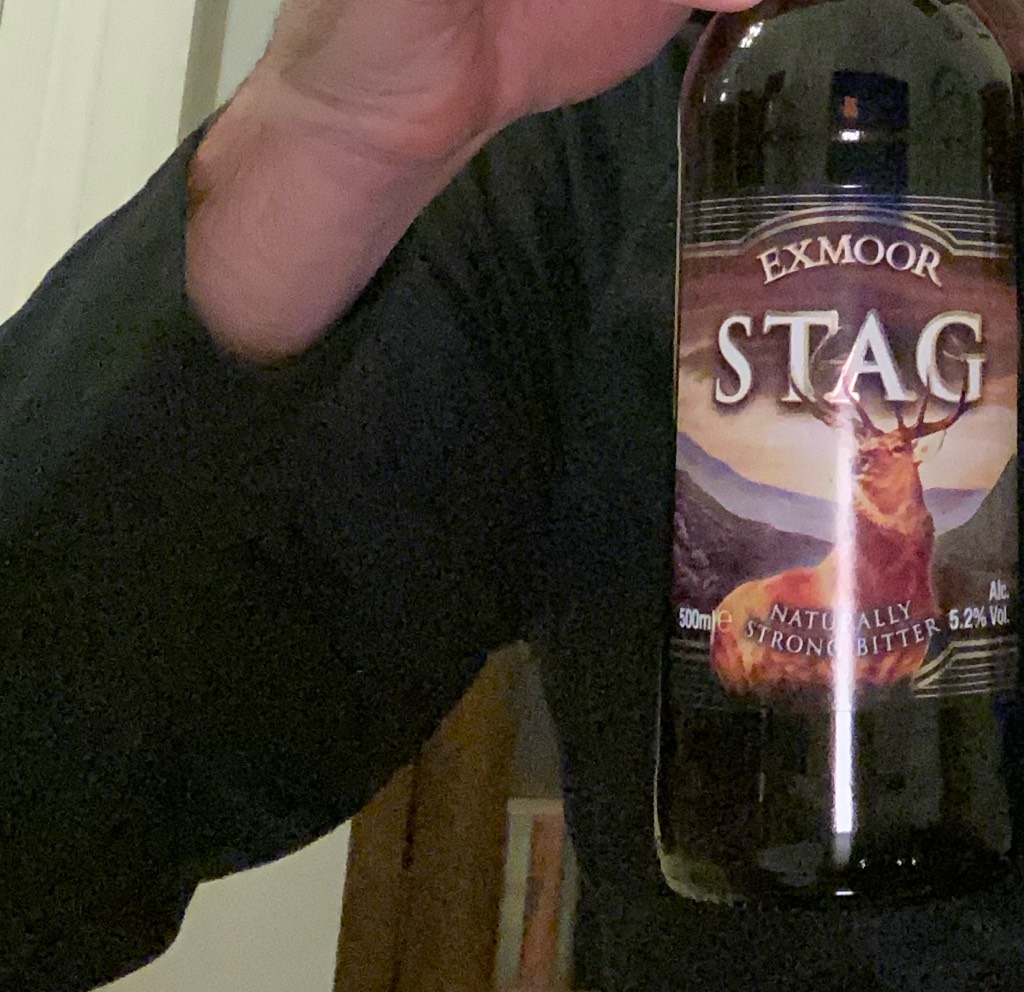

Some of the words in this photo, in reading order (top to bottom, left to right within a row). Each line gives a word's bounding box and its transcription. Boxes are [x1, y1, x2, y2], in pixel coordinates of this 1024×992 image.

[757, 234, 942, 287] EXMOOR
[714, 309, 986, 404] STAG
[857, 617, 941, 656] BITTER
[949, 606, 987, 630] 5.2%
